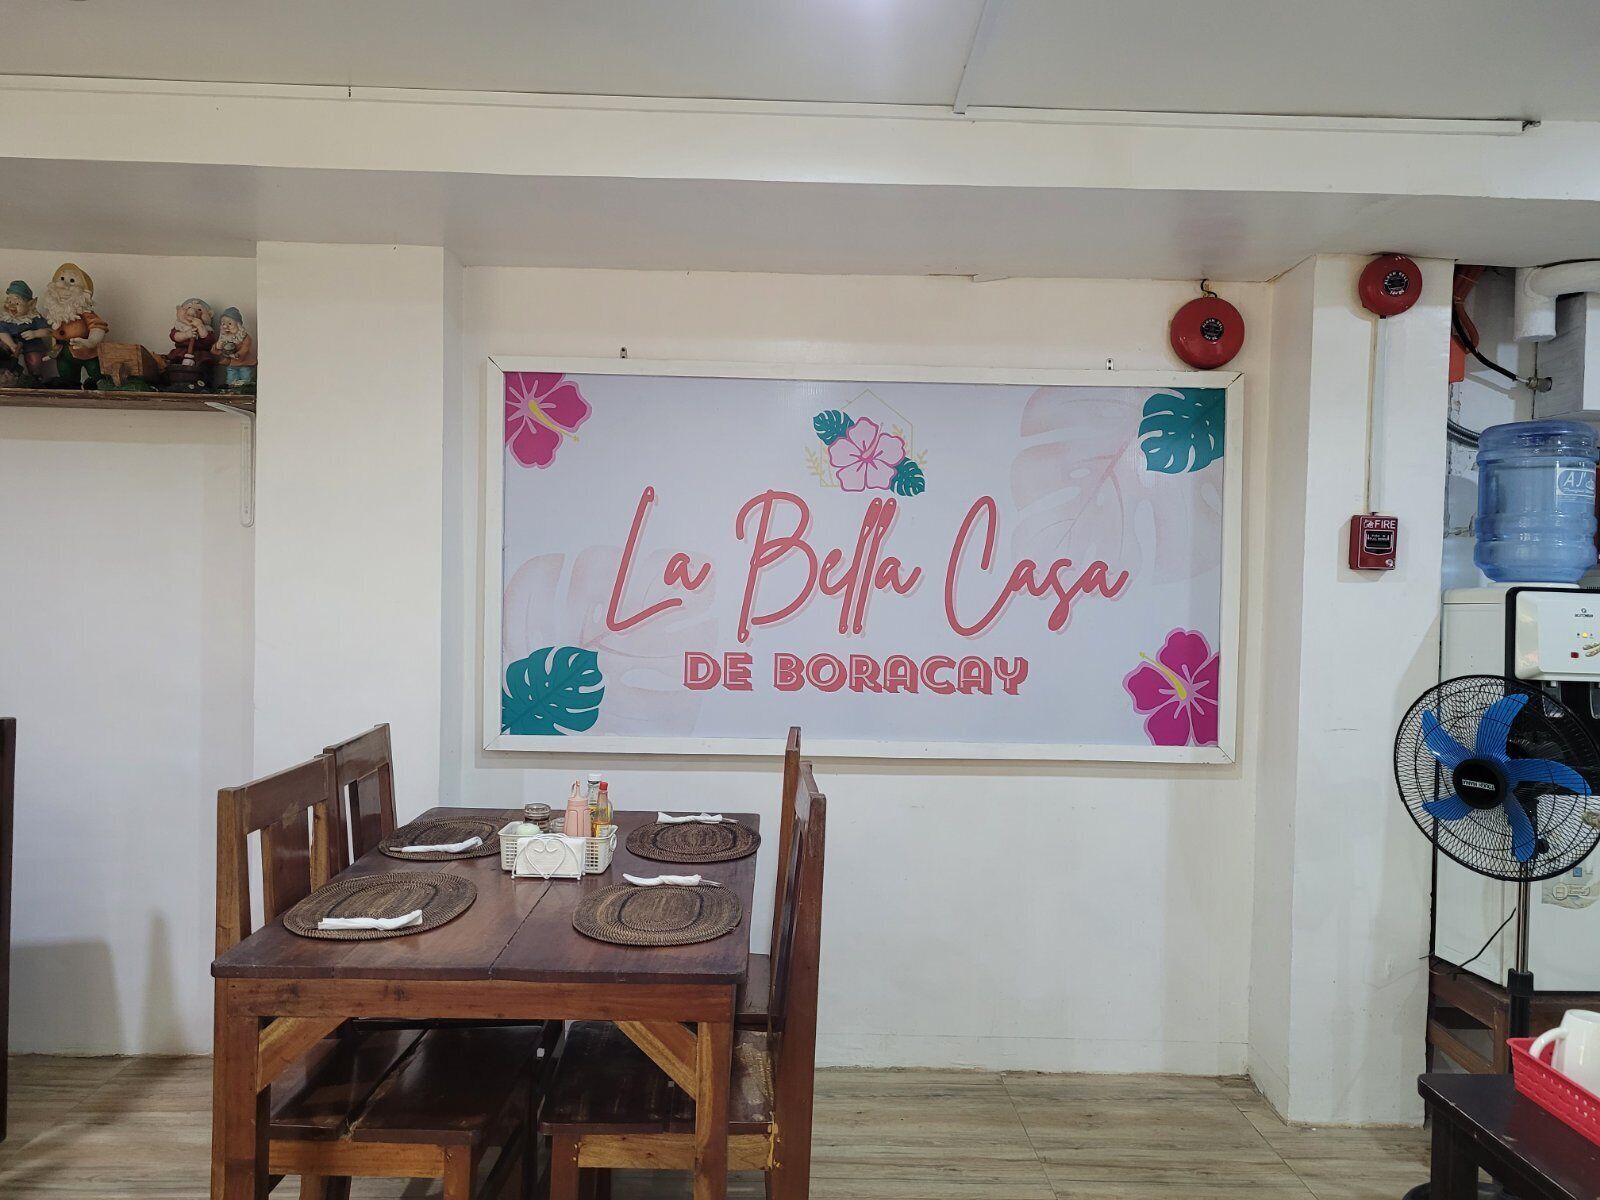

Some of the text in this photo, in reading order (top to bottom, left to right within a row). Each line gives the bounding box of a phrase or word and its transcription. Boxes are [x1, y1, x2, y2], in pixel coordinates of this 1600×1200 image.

[1374, 519, 1396, 529] FIRE
[605, 486, 1131, 644] La Bella Casa
[683, 651, 1029, 696] DE BORACAY
